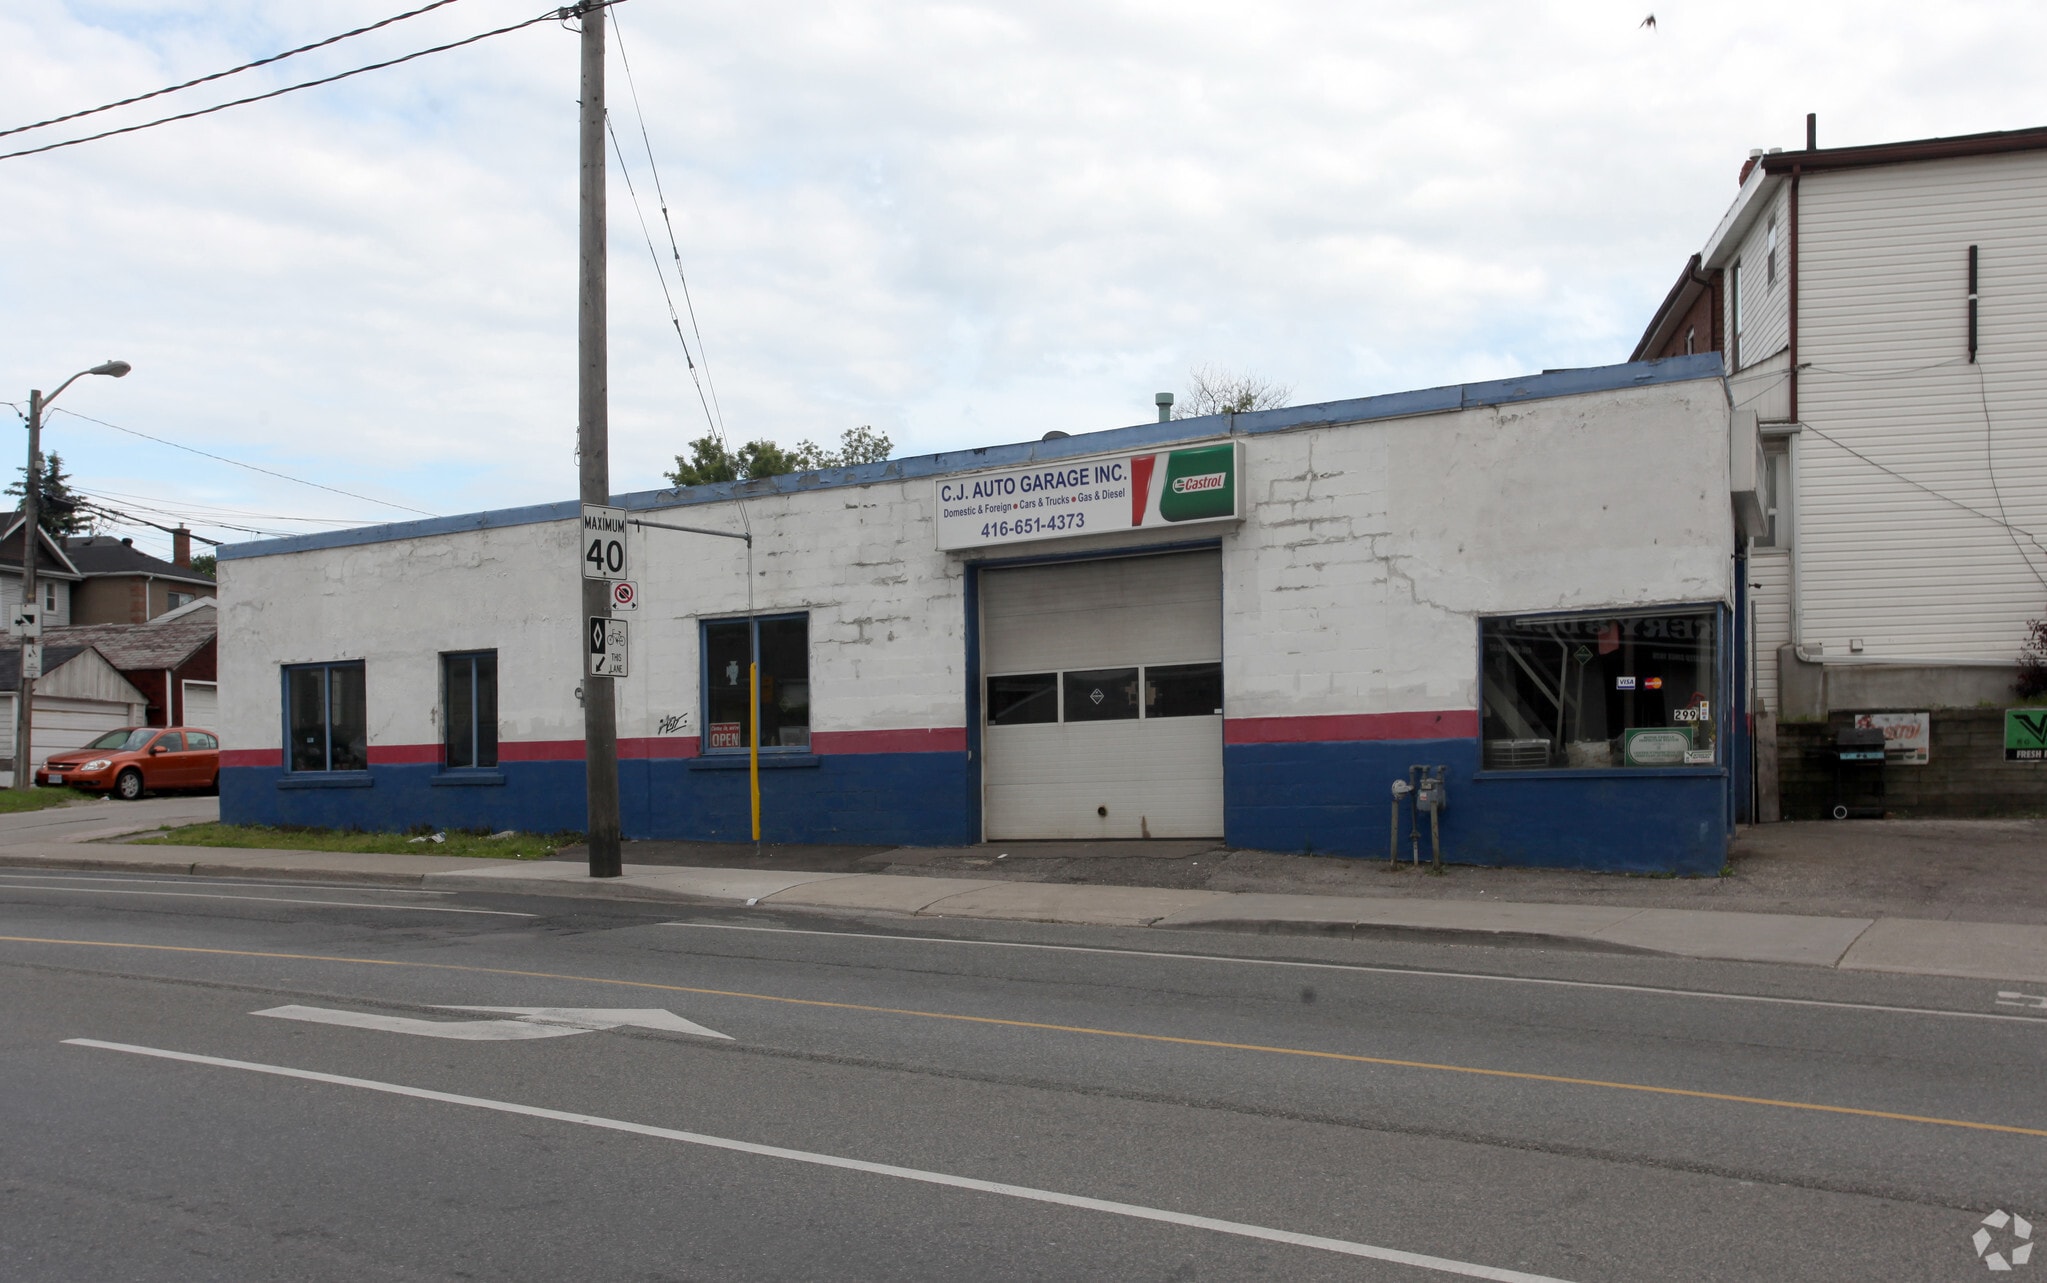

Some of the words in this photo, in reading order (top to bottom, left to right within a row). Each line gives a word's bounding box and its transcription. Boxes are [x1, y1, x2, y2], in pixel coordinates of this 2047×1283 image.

[941, 485, 969, 502] C.J.
[972, 477, 1016, 499] AUTO
[1020, 467, 1089, 493] GARAGE
[1095, 463, 1127, 483] INC.
[1185, 475, 1222, 491] Castrol
[943, 505, 976, 519] Domestic
[977, 504, 984, 514] &
[985, 501, 1012, 515] Foreign
[1019, 498, 1037, 510] Cars
[1037, 497, 1044, 507] &
[1045, 494, 1070, 506] Trucks
[1078, 491, 1093, 503] Gas
[1094, 490, 1101, 500] &
[1102, 487, 1126, 500] Diesel
[585, 515, 625, 534] MAXIMUM
[981, 512, 1085, 539] 416-651-4373
[586, 538, 624, 573] 40
[611, 652, 622, 662] THIS
[609, 663, 623, 674] LANE
[1675, 710, 1696, 720] 299
[711, 733, 739, 747] OPEN
[2016, 749, 2042, 759] FRESH
